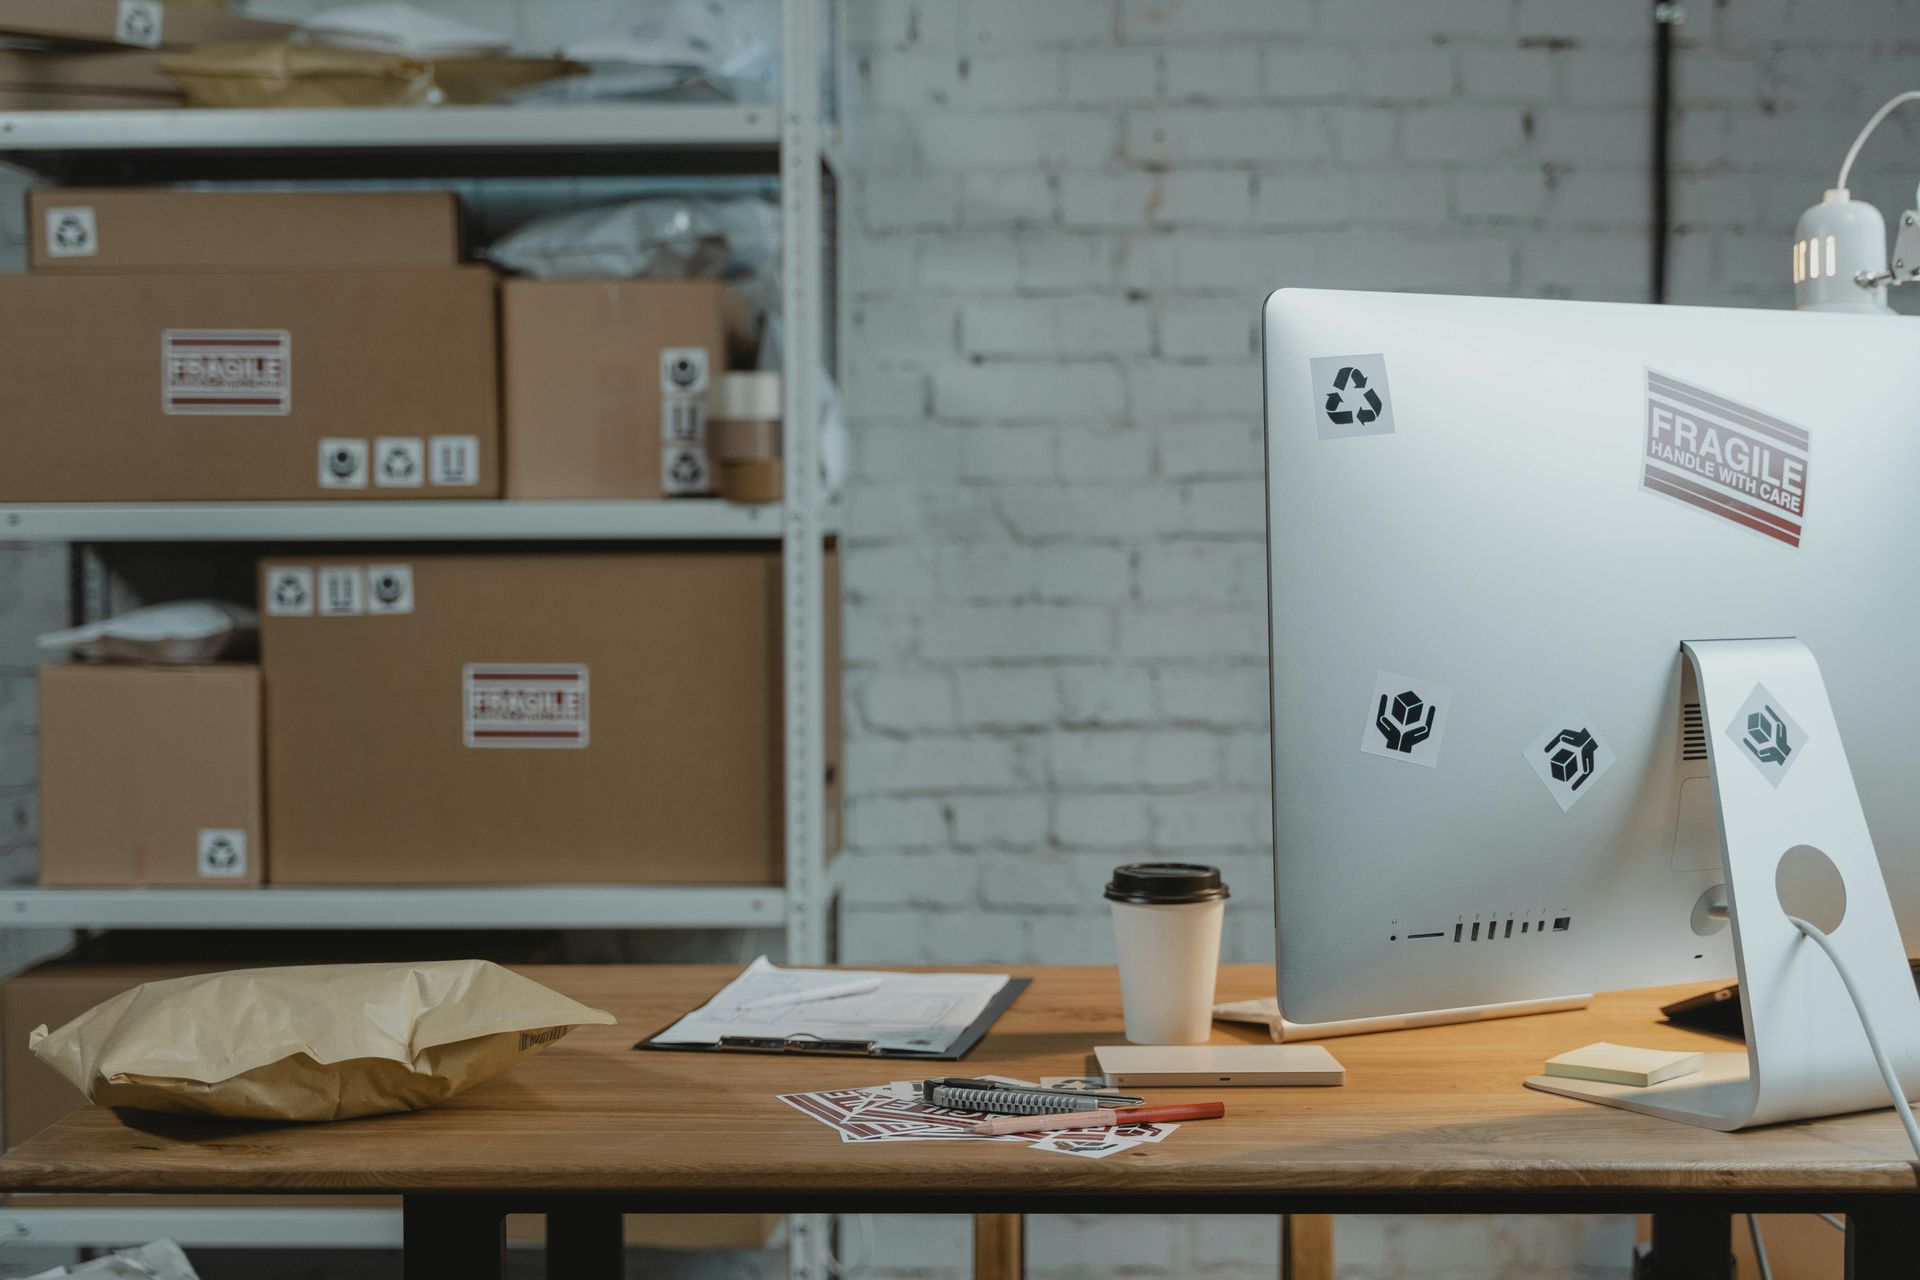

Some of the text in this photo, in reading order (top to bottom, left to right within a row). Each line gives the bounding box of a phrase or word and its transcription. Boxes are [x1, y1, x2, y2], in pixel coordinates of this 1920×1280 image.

[172, 357, 281, 379] FRAGILE
[1651, 406, 1804, 497] FRAGILE
[1651, 440, 1801, 513] HANDLE WITH CARE
[474, 691, 580, 713] FRAGILE
